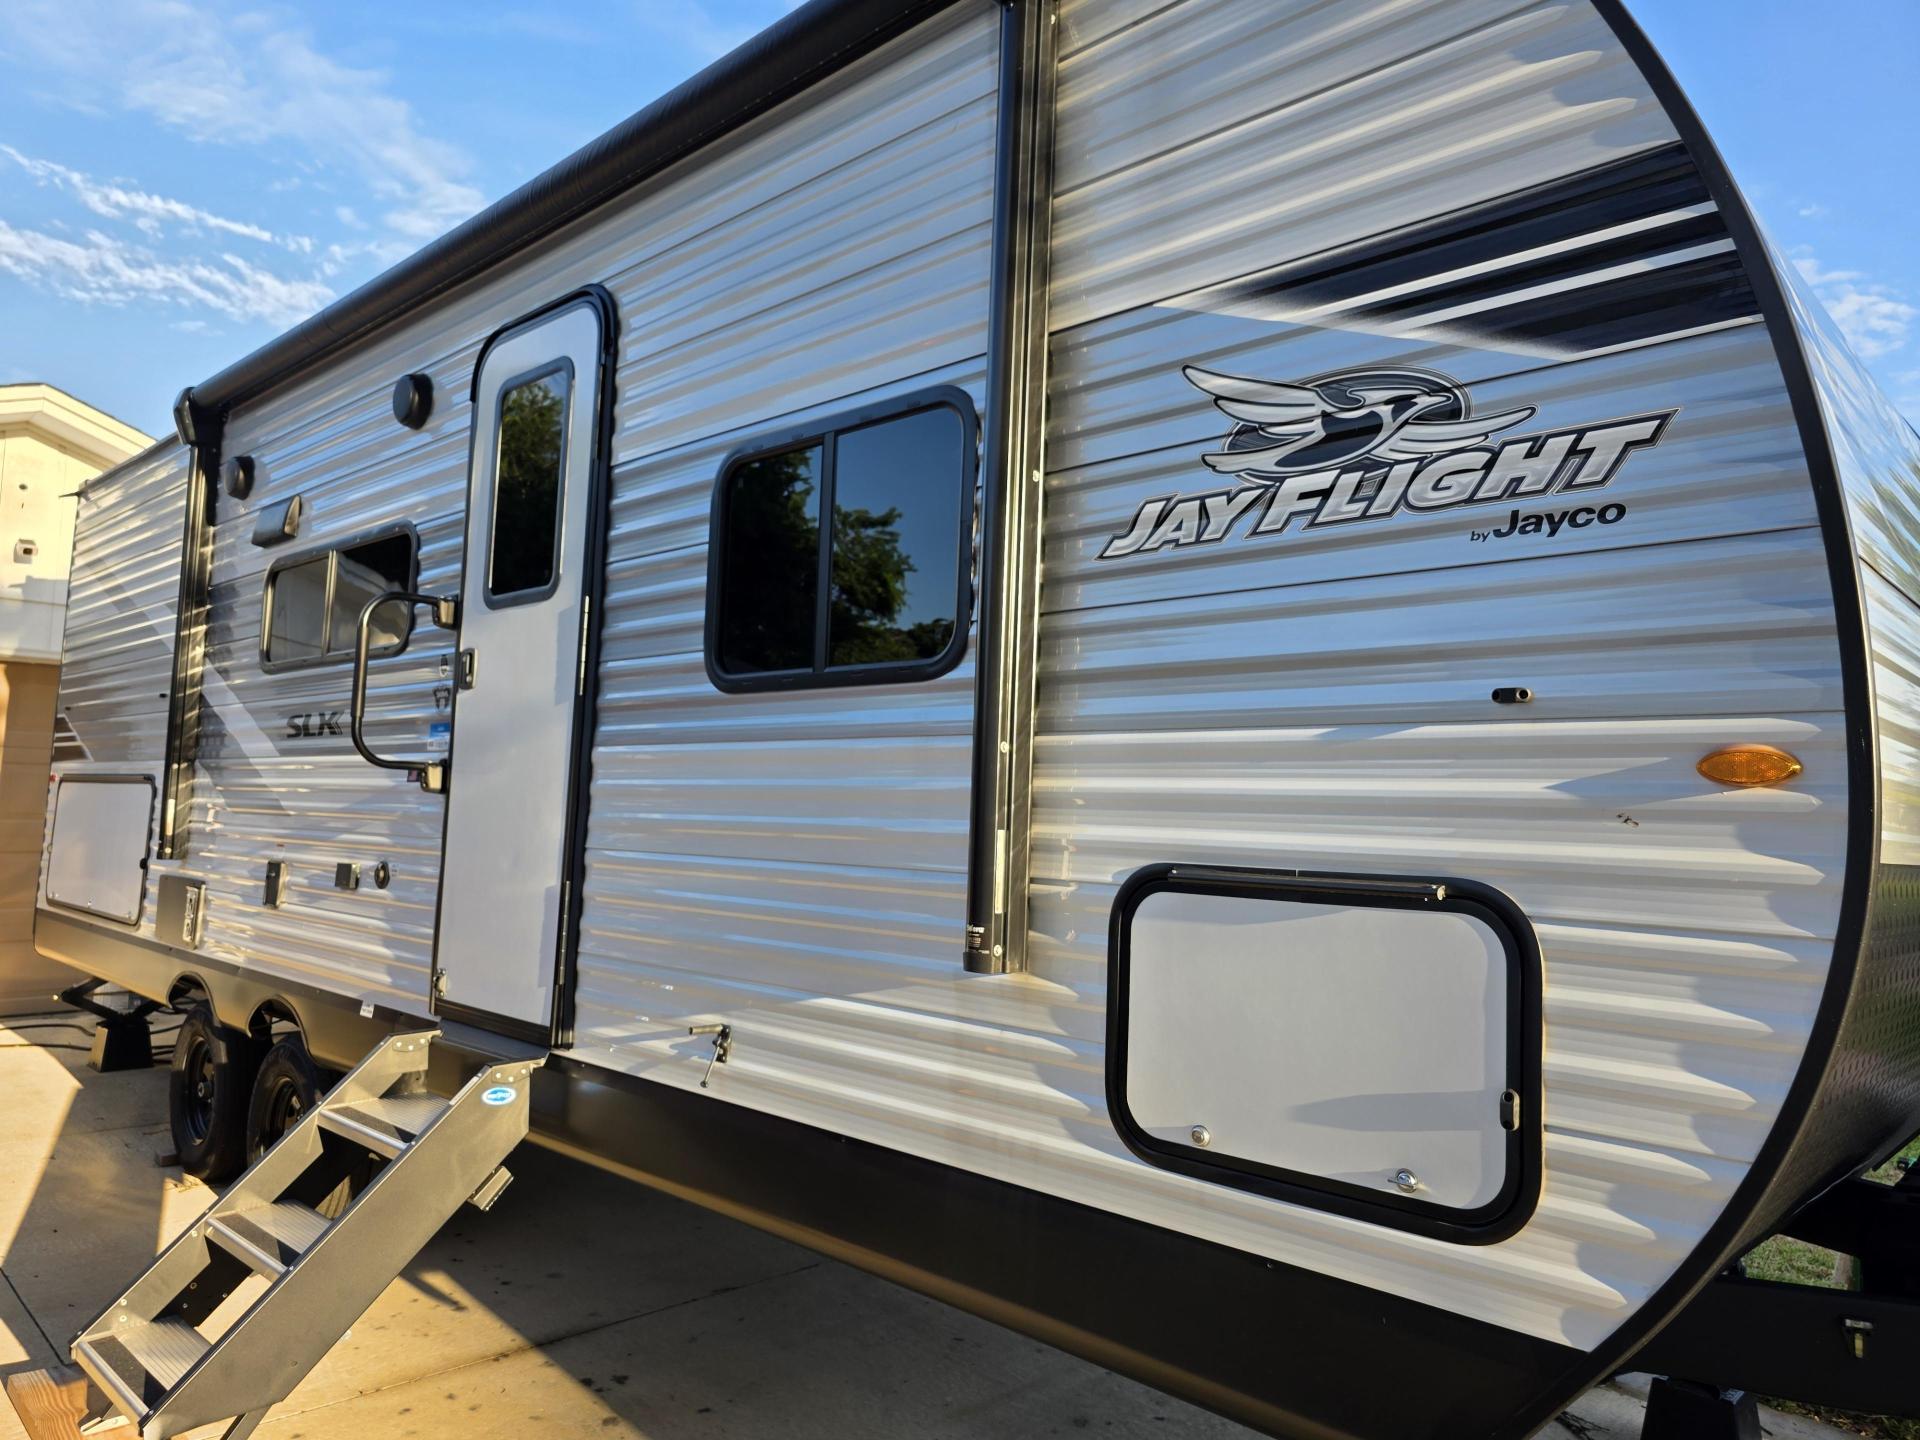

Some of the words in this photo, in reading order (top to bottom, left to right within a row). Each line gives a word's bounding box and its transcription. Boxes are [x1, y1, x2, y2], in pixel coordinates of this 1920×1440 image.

[1470, 530, 1490, 543] by
[1492, 503, 1627, 537] Jayco
[286, 711, 344, 738] SLK
